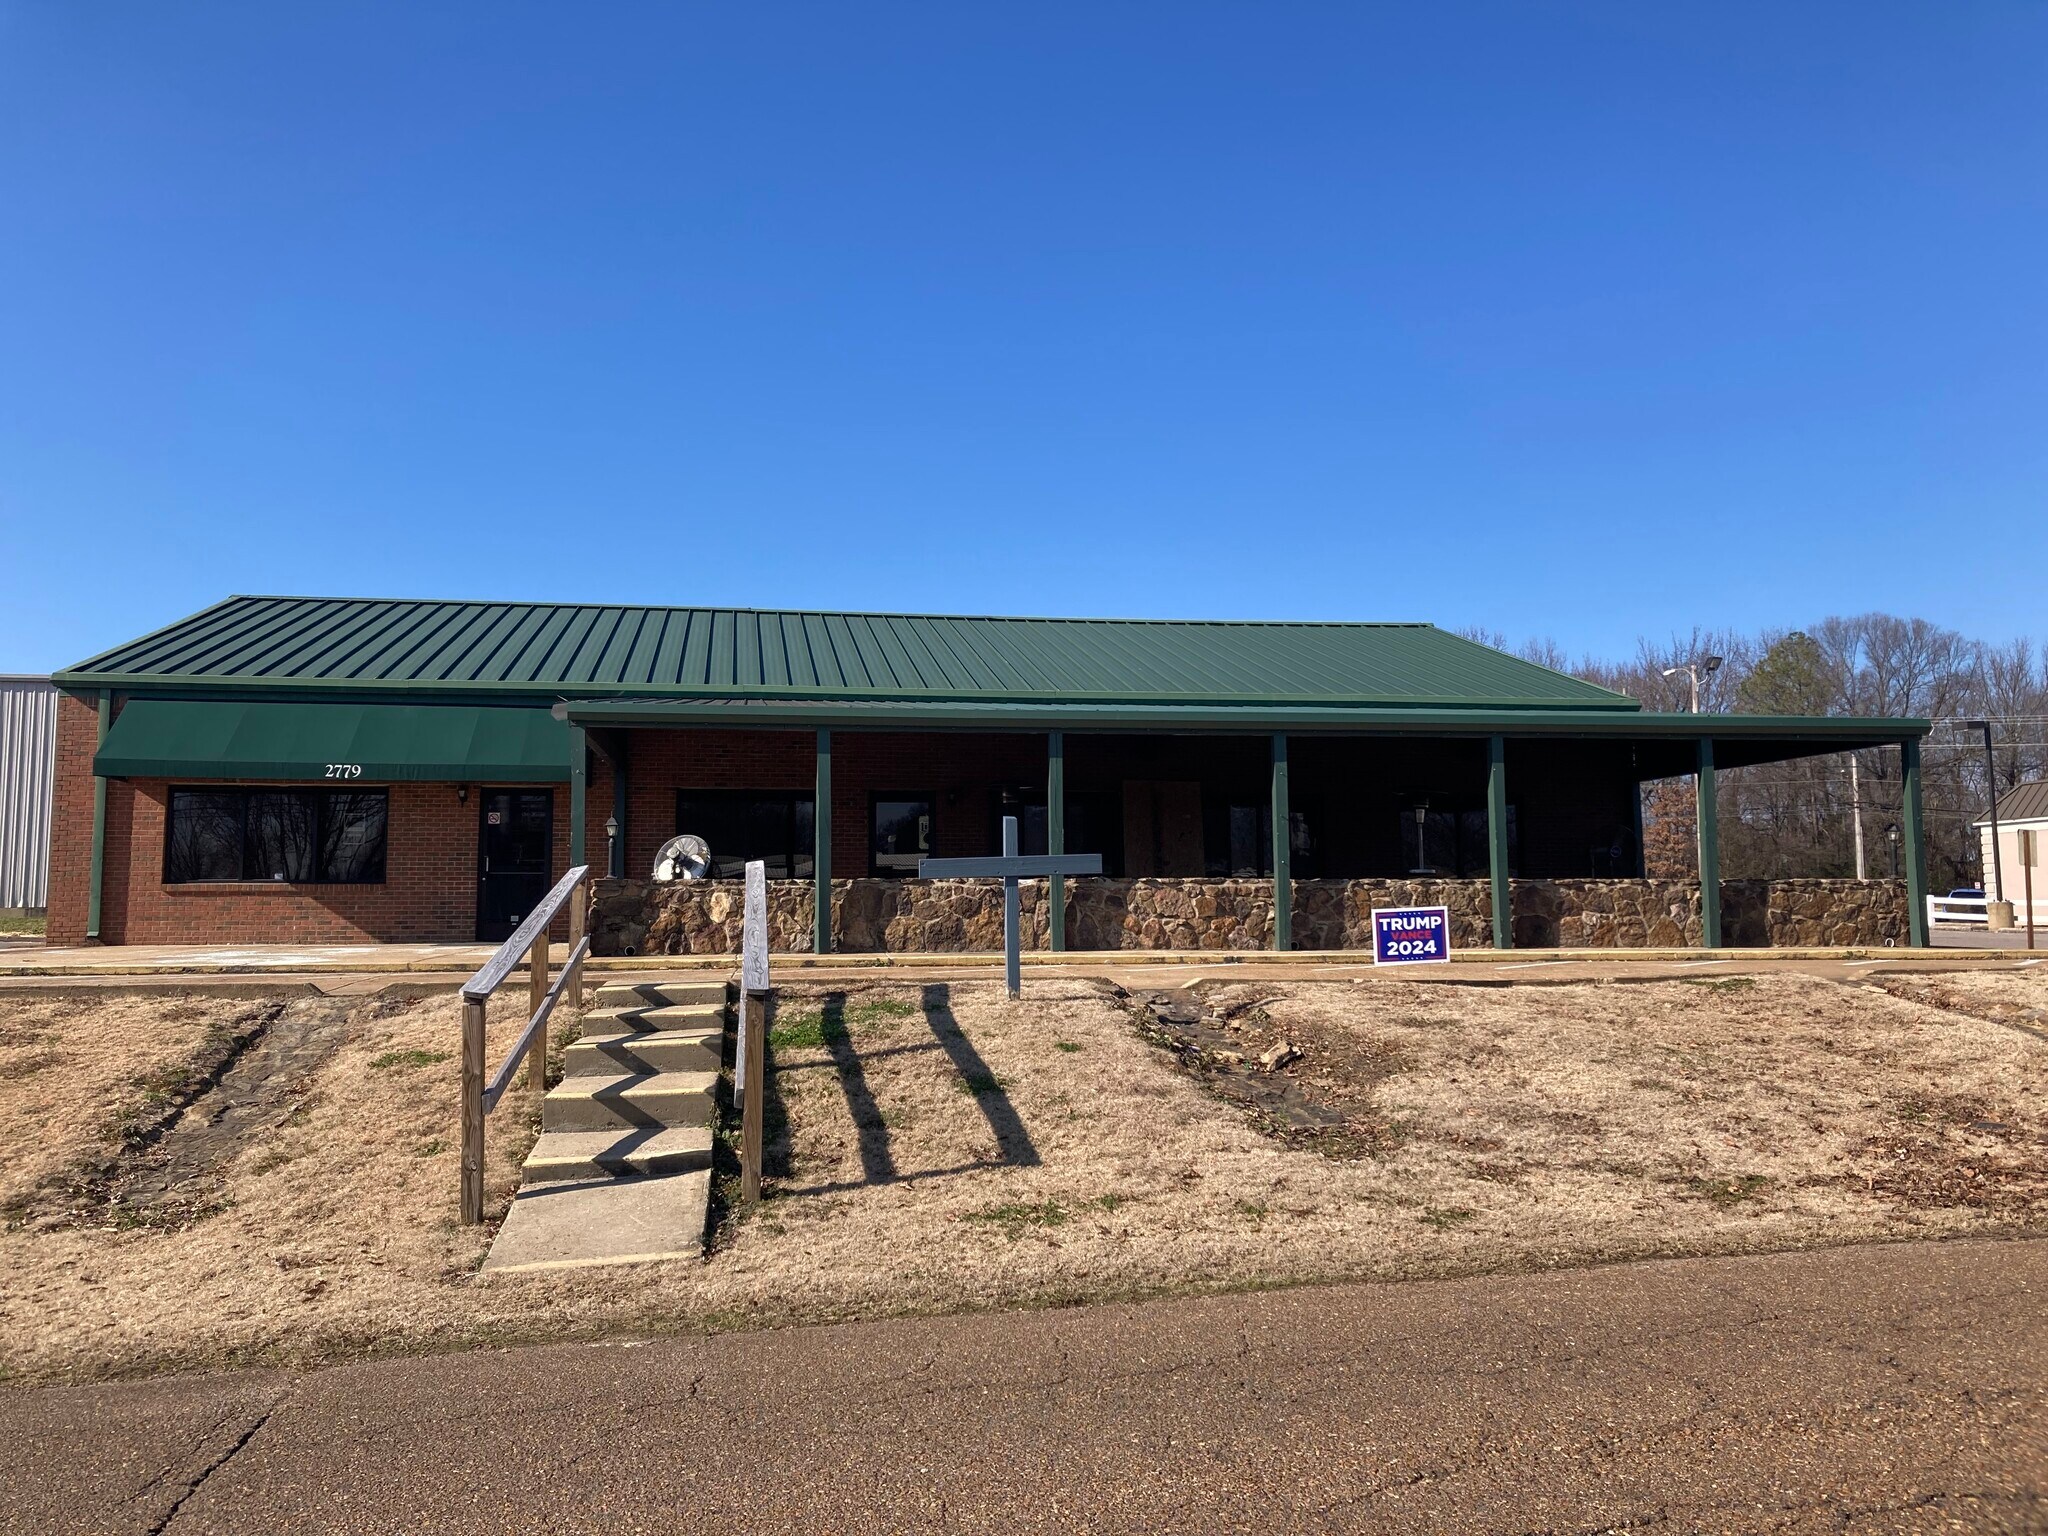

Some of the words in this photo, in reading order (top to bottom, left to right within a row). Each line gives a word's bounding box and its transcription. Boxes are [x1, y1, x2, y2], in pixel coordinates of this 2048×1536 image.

[325, 764, 361, 778] 2779
[1379, 916, 1442, 931] TRUMP
[1391, 930, 1432, 940] VANCE
[1387, 940, 1437, 956] 2024
